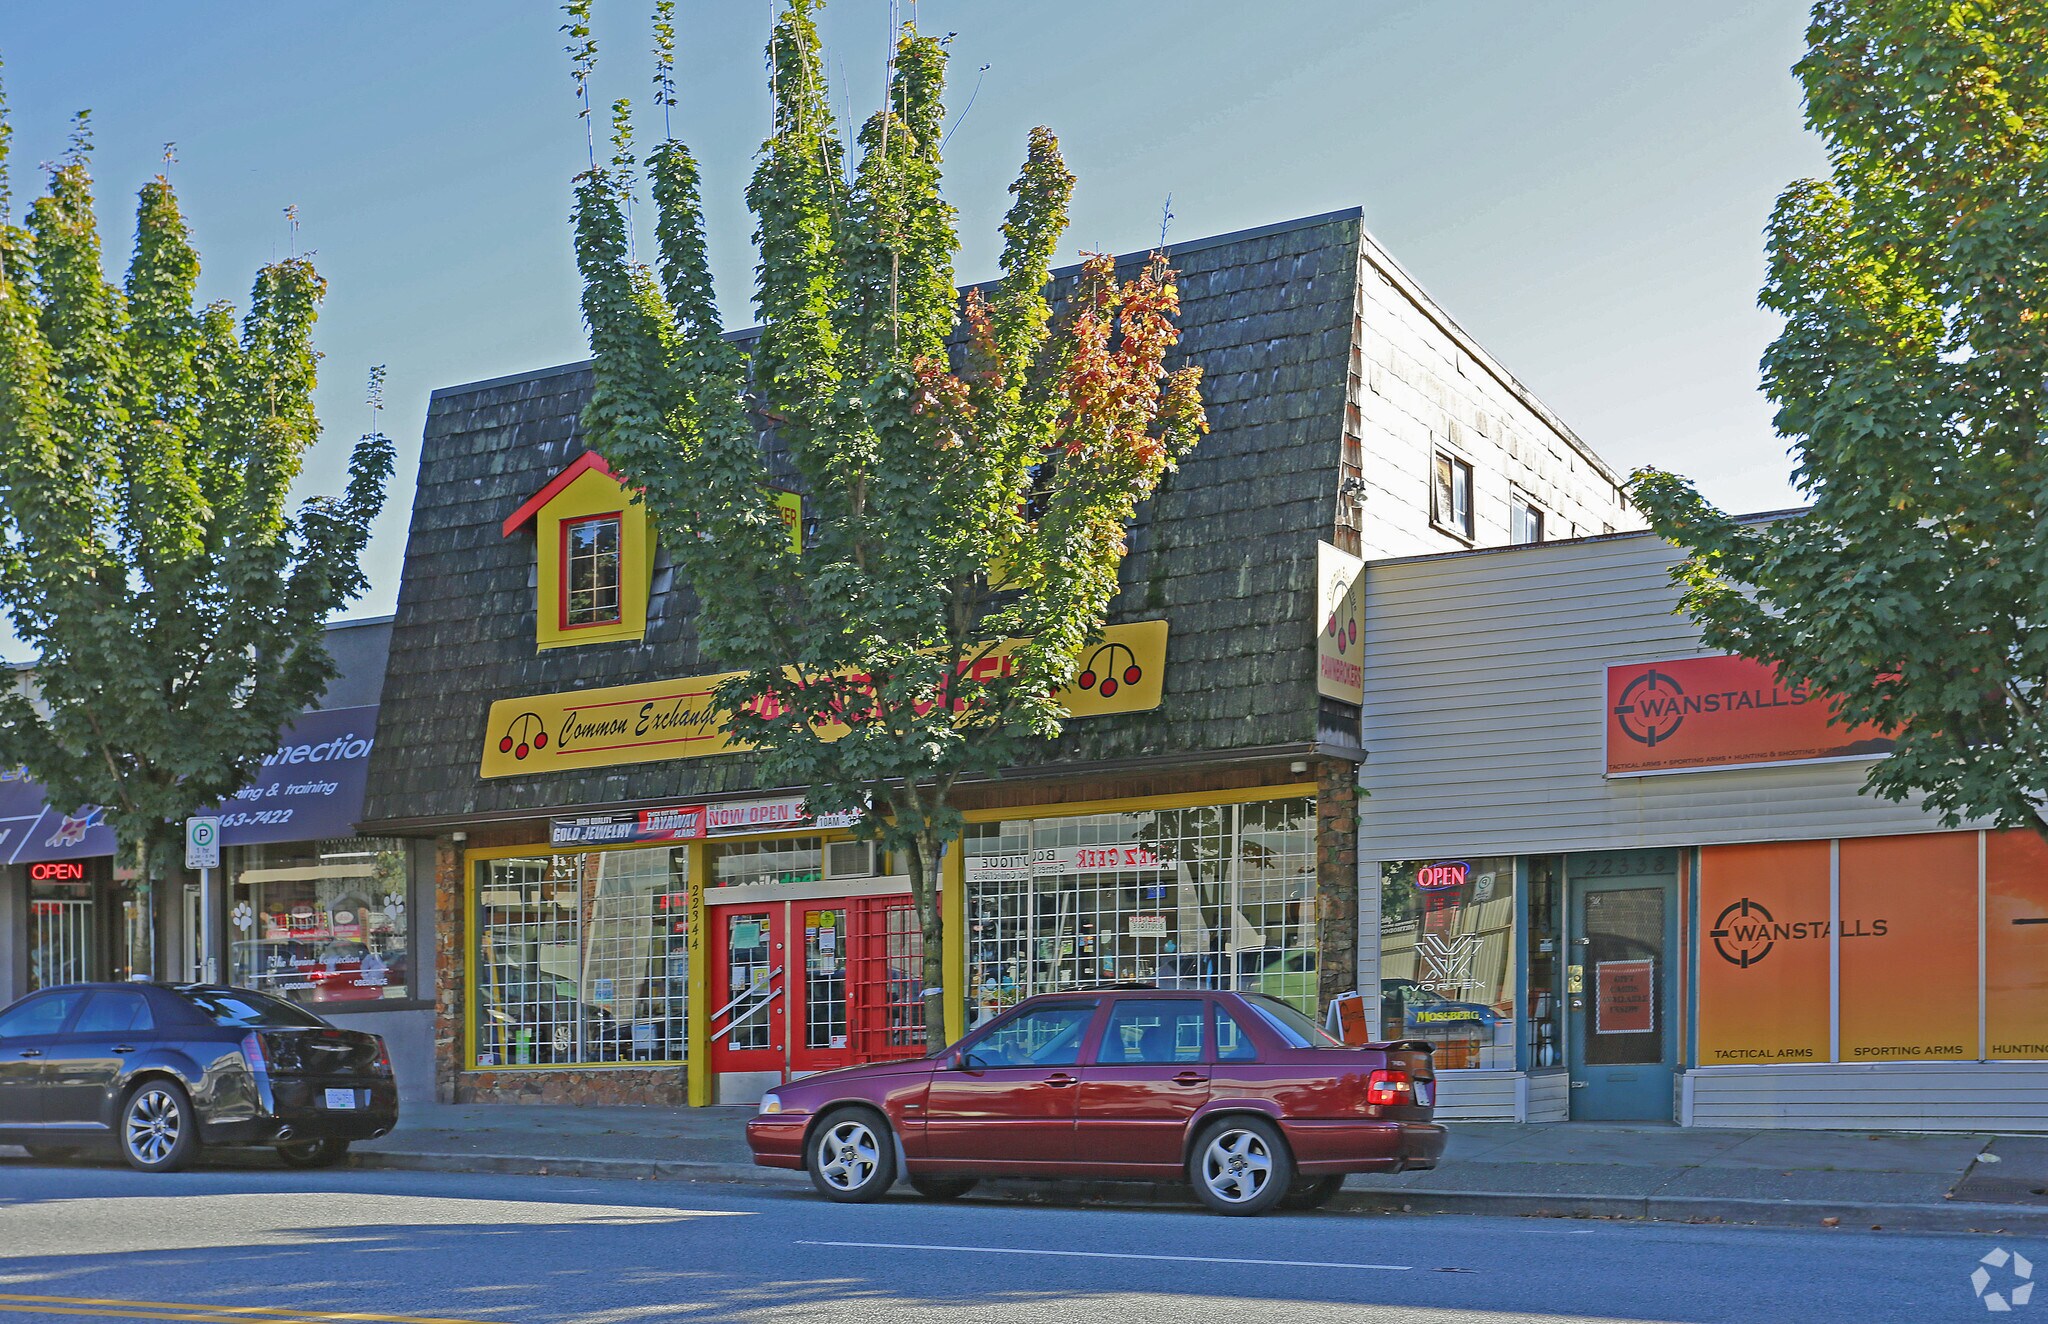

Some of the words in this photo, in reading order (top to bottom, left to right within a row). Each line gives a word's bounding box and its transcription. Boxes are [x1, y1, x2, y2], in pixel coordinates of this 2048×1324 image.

[1640, 687, 1808, 718] WANSTALLS
[558, 711, 628, 748] Common
[262, 733, 375, 767] nectio
[1608, 763, 1639, 771] TACTICAL
[1669, 758, 1704, 766] SPORTING
[1706, 755, 1726, 763] ARMS
[1734, 752, 1767, 760] HUNTING
[1778, 749, 1816, 757] SHOOTING
[265, 782, 280, 797] &
[284, 780, 338, 796] training
[576, 818, 589, 826] HIGH
[590, 816, 612, 825] QUALITY
[646, 813, 698, 831] LAYAWAY
[709, 809, 745, 826] NOW
[749, 805, 788, 823] OPEN
[820, 816, 840, 827] 10AM
[199, 829, 208, 841] P
[553, 827, 580, 842] GOLD
[581, 823, 633, 840] JEWELRY
[674, 828, 696, 838] PLANS
[32, 864, 82, 880] OPEN
[1417, 866, 1466, 887] OPEN
[1733, 919, 1888, 942] WANSTALLS
[284, 982, 317, 991] GROOMING
[1408, 980, 1486, 992] VORTEX
[1715, 1049, 1774, 1059] TACTICAL
[1776, 1049, 1813, 1057] ARMS
[1854, 1046, 1921, 1056] SPORTING
[1924, 1045, 1963, 1054] ARMS
